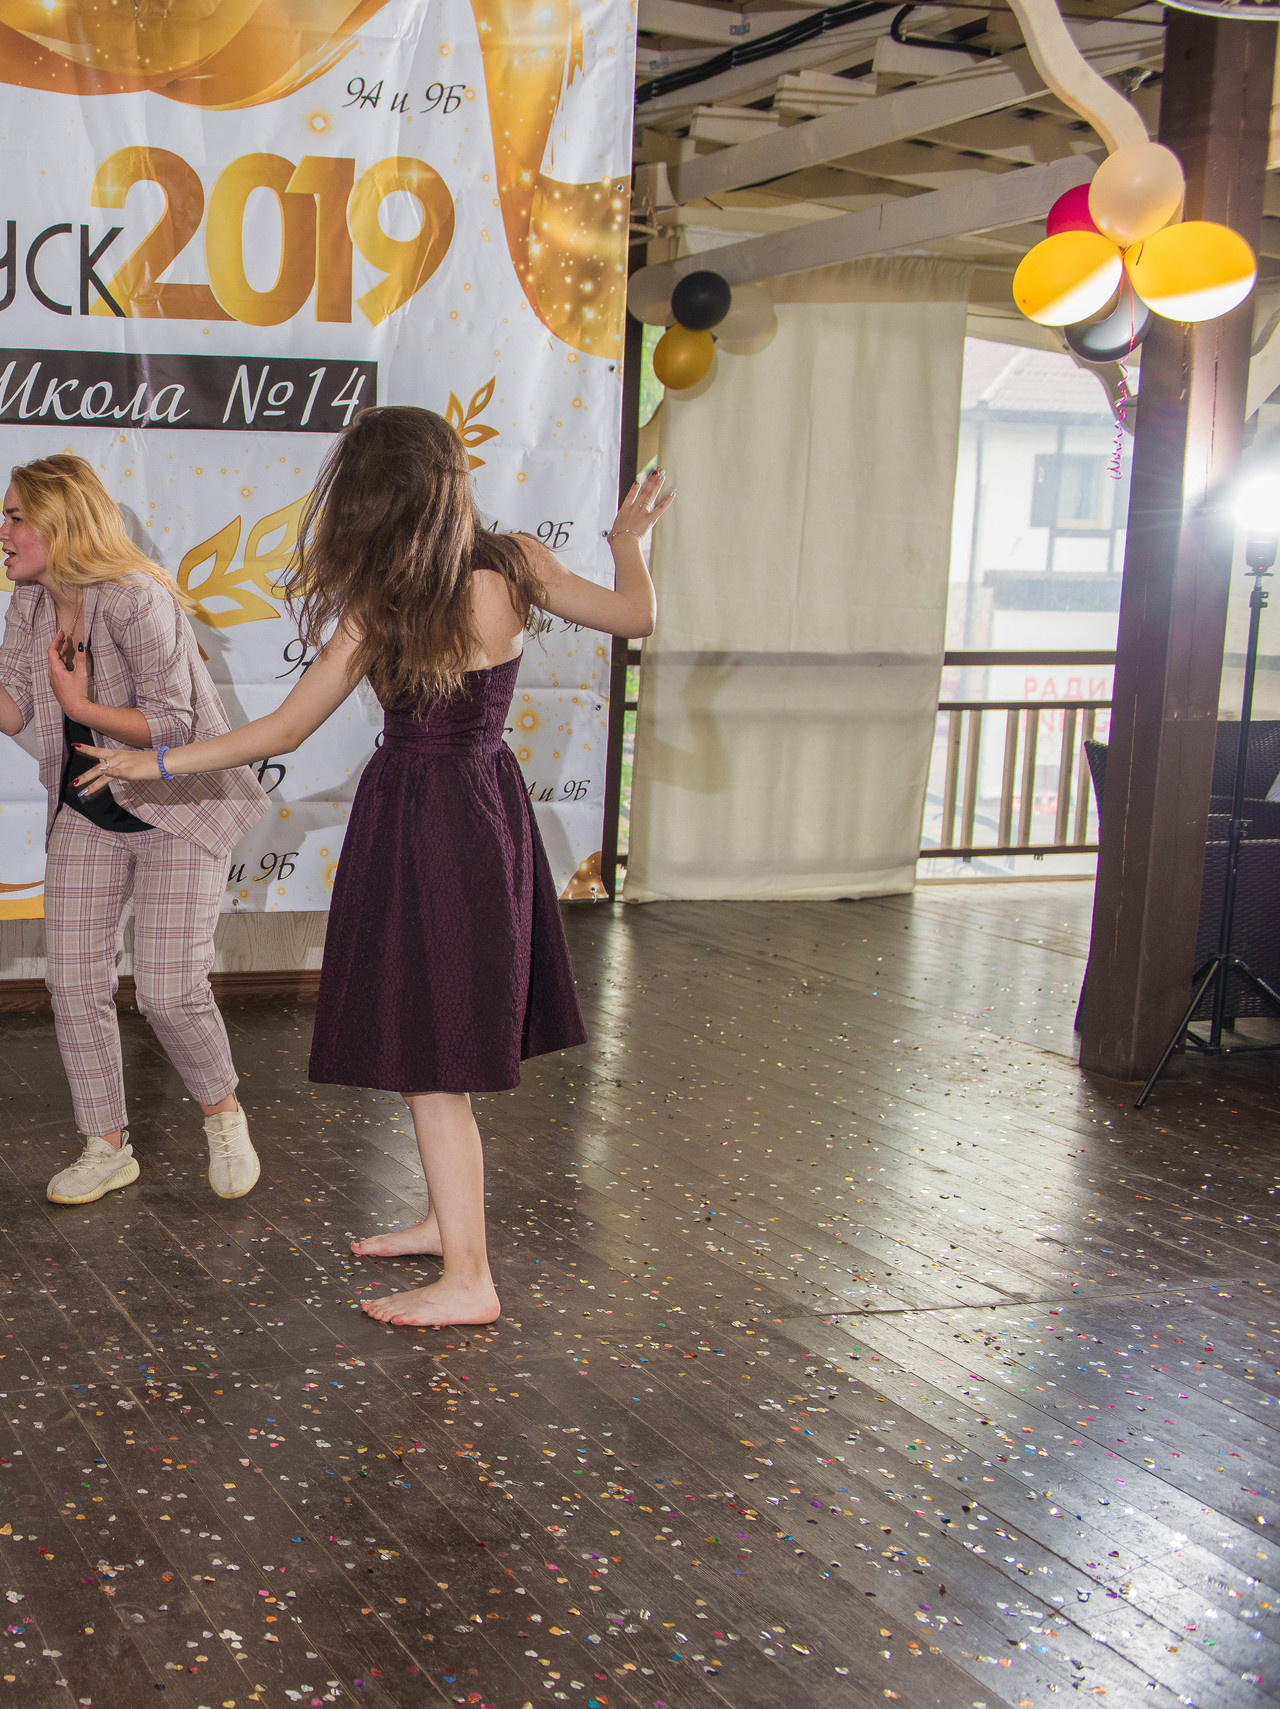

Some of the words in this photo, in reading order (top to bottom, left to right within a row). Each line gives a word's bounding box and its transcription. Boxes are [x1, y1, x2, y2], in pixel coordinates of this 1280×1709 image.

[341, 76, 384, 110] 9А
[389, 92, 411, 114] и
[419, 82, 466, 115] 9Б
[90, 146, 456, 328] 2019
[1023, 676, 1113, 702] РАДИ
[558, 779, 592, 802] 9Б
[228, 862, 248, 883] и
[254, 852, 300, 882] 9Б
